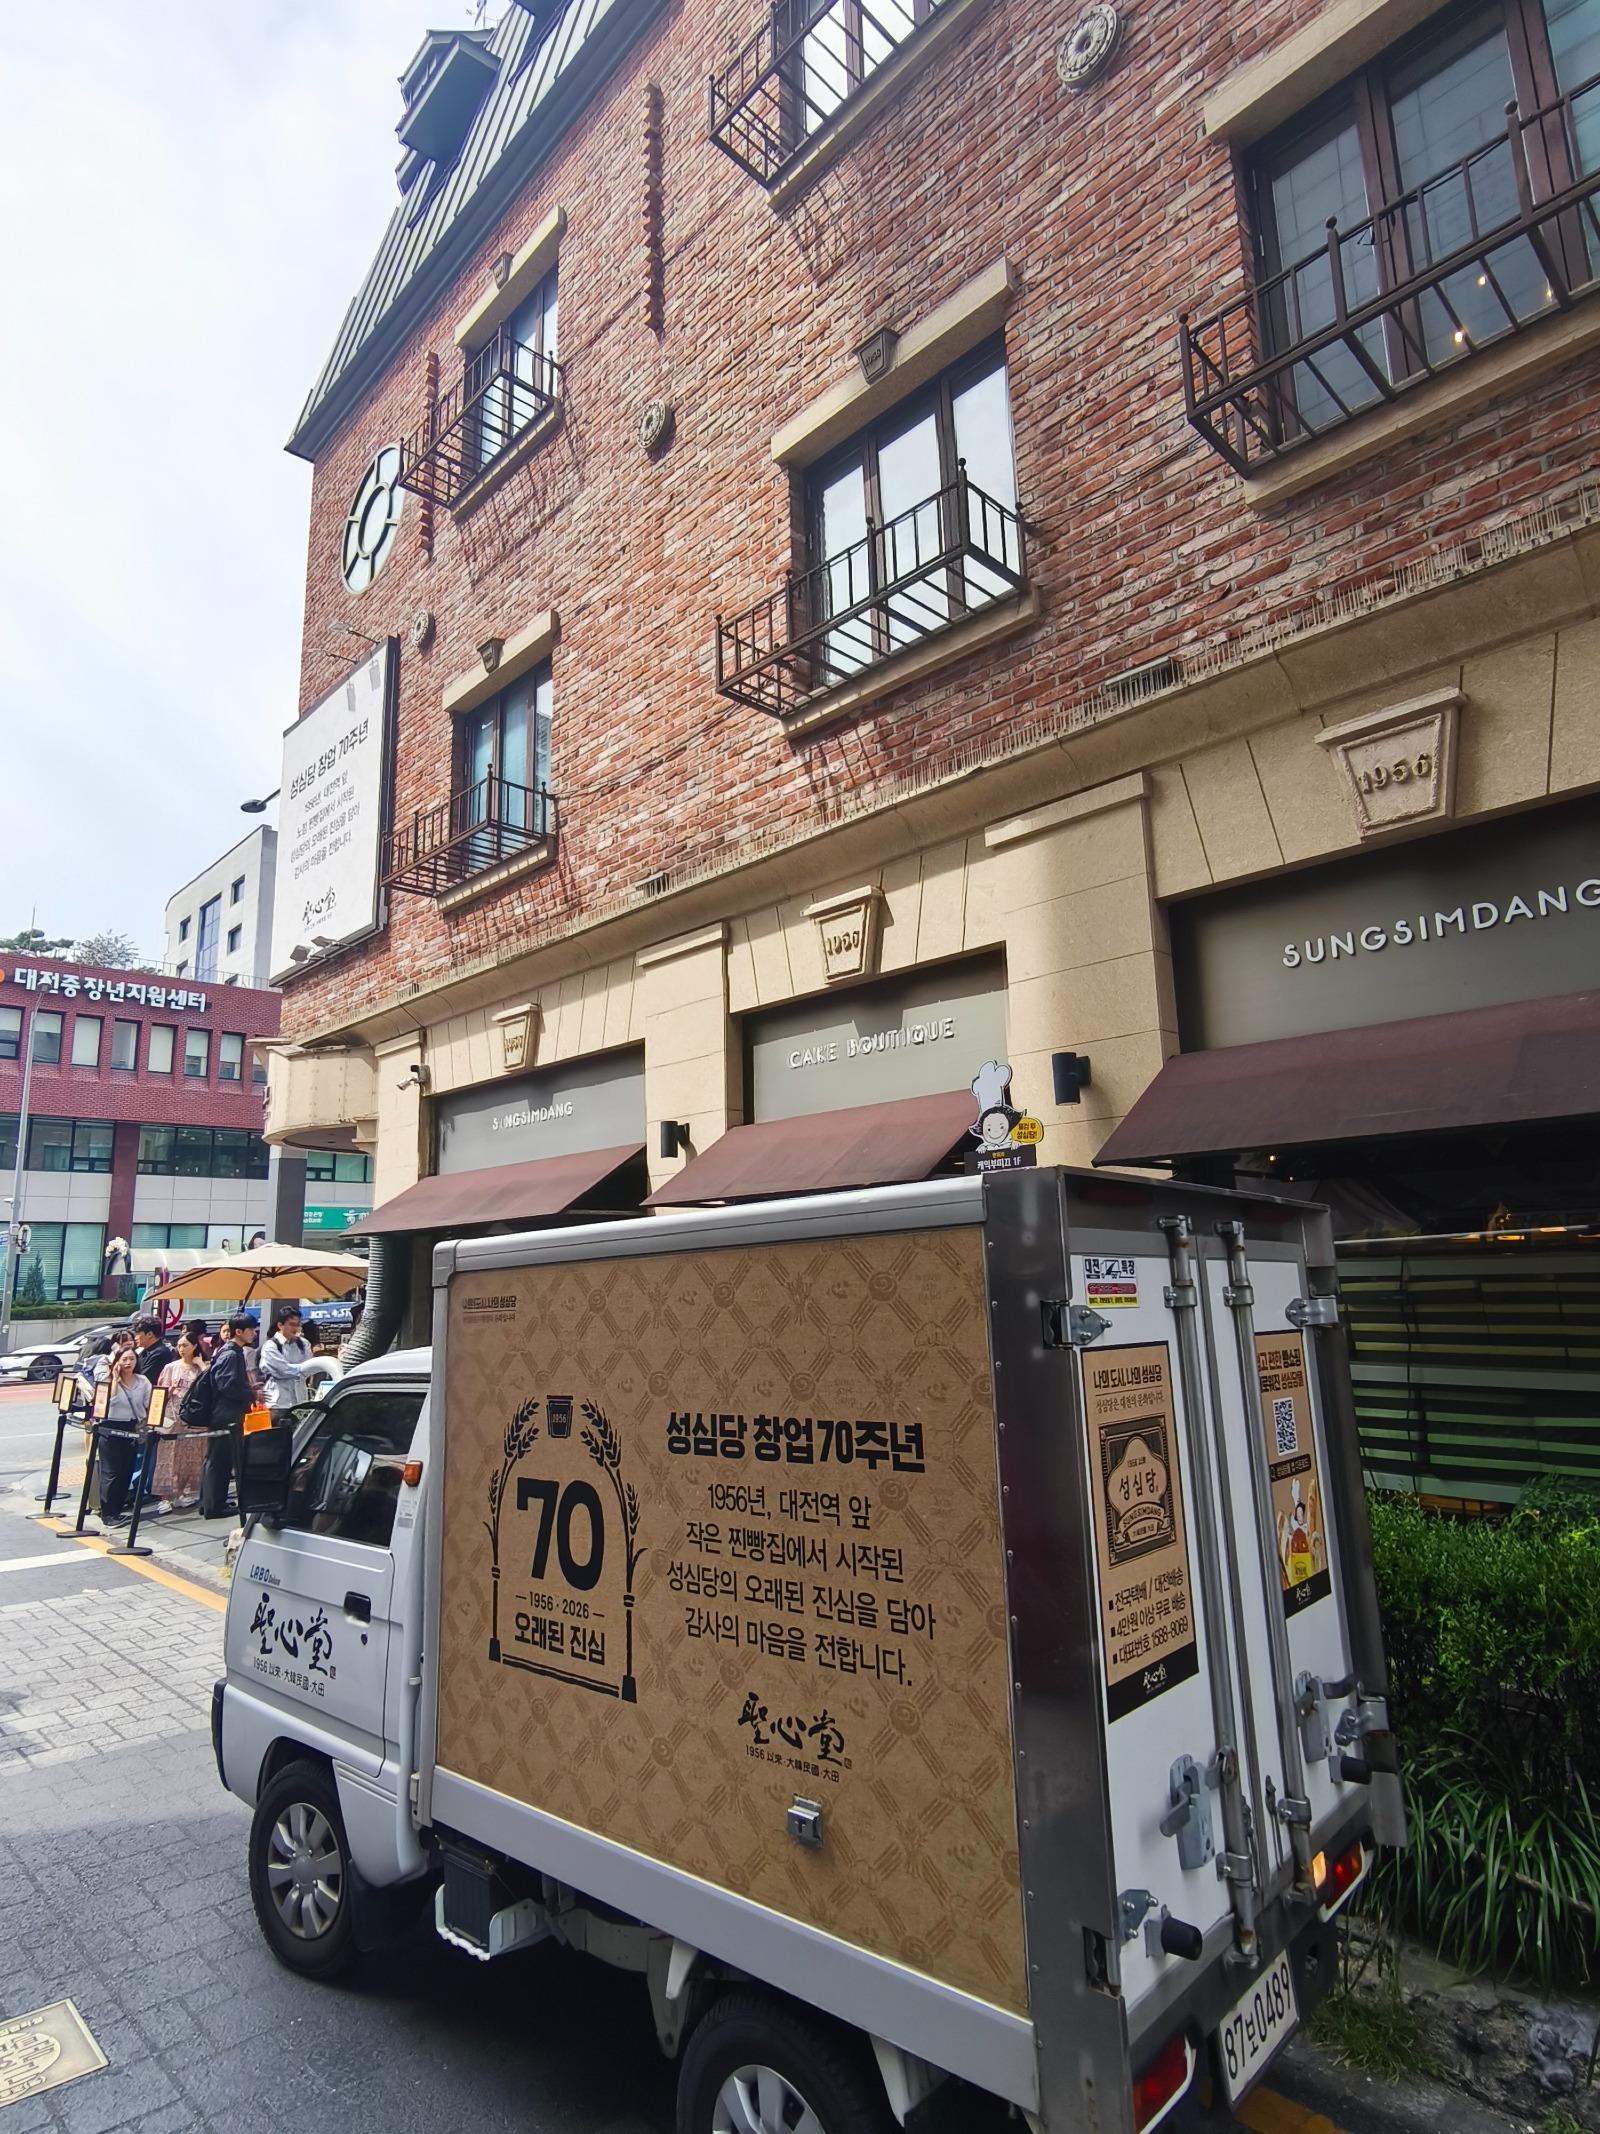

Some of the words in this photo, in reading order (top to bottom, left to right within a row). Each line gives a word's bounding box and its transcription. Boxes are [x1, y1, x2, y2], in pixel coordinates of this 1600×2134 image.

[290, 762, 316, 800] 성심당
[318, 744, 336, 778] 창업
[339, 717, 369, 760] 70주년
[1357, 752, 1431, 795] 1956
[1282, 878, 1600, 969] SUNGSIMDANG
[14, 967, 206, 1013] 대전중장년지원센터
[788, 1042, 838, 1070] CAKE
[846, 1017, 956, 1058] BOUTIQUE
[492, 1101, 574, 1131] SUNGSIMDANG
[1013, 1155, 1021, 1166] 1F
[1092, 1368, 1109, 1389] 나의
[1126, 1365, 1141, 1386] 나의
[1141, 1364, 1163, 1383] 성심당
[666, 1411, 748, 1459] 성심당
[753, 1414, 814, 1465] 창업
[816, 1419, 926, 1474] 70주년
[707, 1483, 771, 1520] 1956년,
[779, 1489, 841, 1526] 대전역
[848, 1495, 871, 1530] 앞
[1119, 1468, 1157, 1502] 성심당
[516, 1476, 605, 1592] 70
[686, 1520, 722, 1554] 작은
[728, 1526, 828, 1572] 찐빵집에서
[836, 1541, 904, 1584] 시작된
[250, 1564, 270, 1582] LABO
[1114, 1580, 1147, 1612] 전국택배
[667, 1560, 738, 1602] 성심당의
[744, 1574, 805, 1615] 오래된
[812, 1585, 879, 1629] 진심을
[887, 1597, 936, 1640] 담아
[1116, 1610, 1139, 1637] 4만원
[1139, 1607, 1155, 1628] 이상
[514, 1611, 565, 1654] 오래된
[569, 1624, 605, 1666] 진심
[684, 1606, 739, 1647] 감사의
[746, 1620, 807, 1662] 마음을
[814, 1632, 912, 1687] 전합니다.
[1119, 1637, 1152, 1664] 대표번호
[253, 1656, 268, 1673] 1956
[737, 1691, 845, 1767] 聖心堂
[745, 1745, 765, 1761] 1956
[1224, 1961, 1291, 2080] 87보0489
